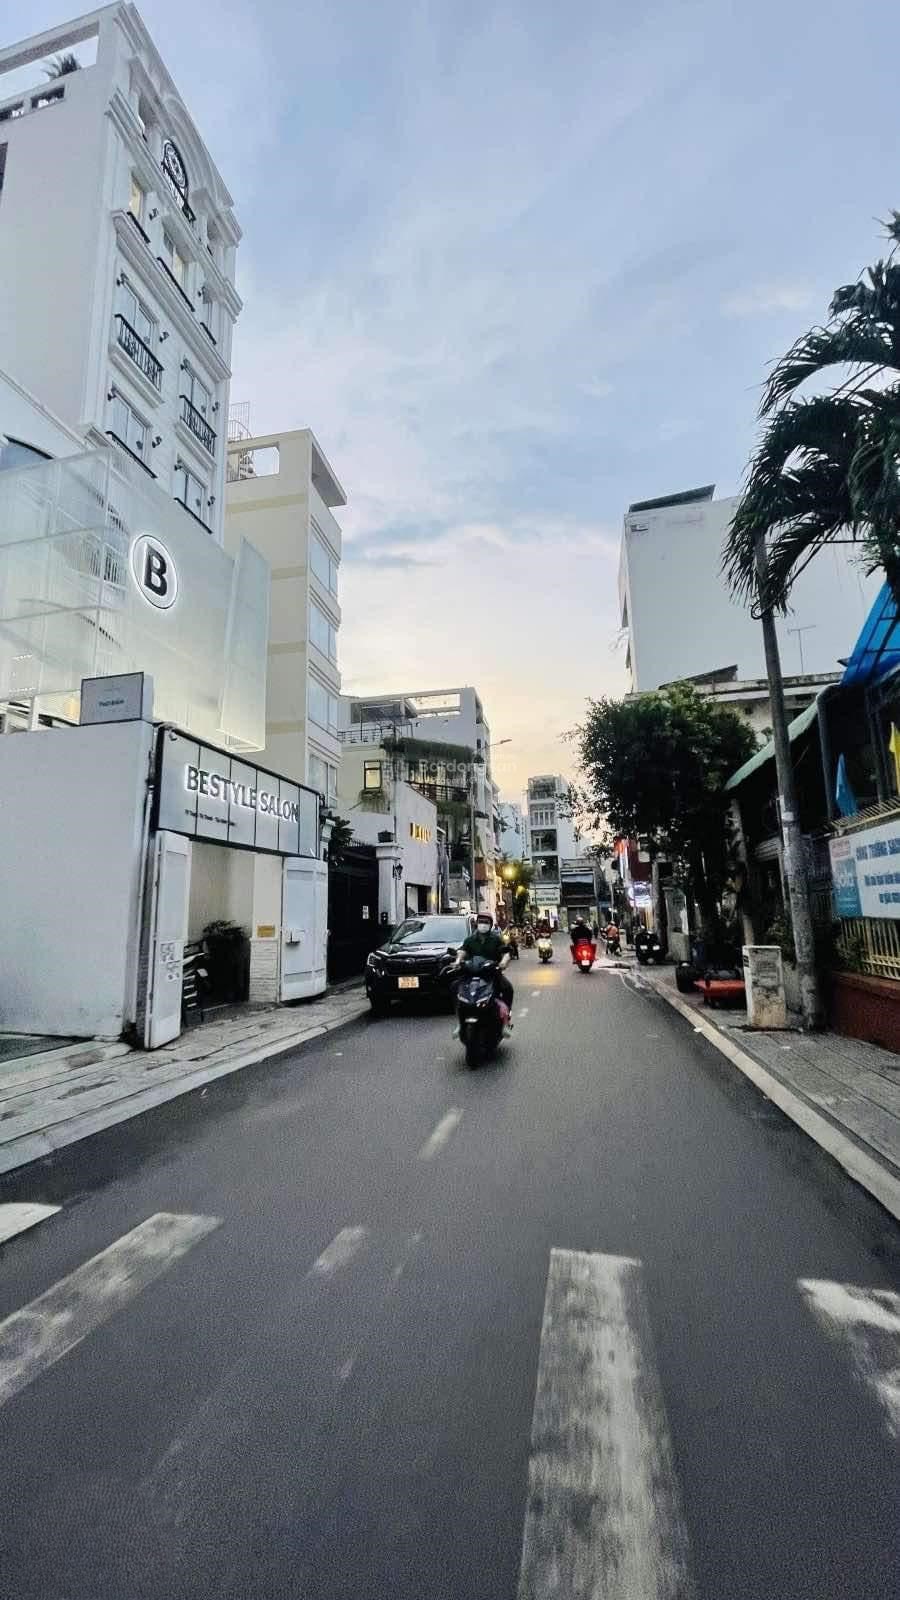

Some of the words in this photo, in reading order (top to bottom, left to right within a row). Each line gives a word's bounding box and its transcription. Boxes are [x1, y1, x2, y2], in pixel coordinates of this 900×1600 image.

[144, 543, 167, 597] B
[185, 764, 257, 809] BESTYLE
[260, 790, 299, 822] SALON
